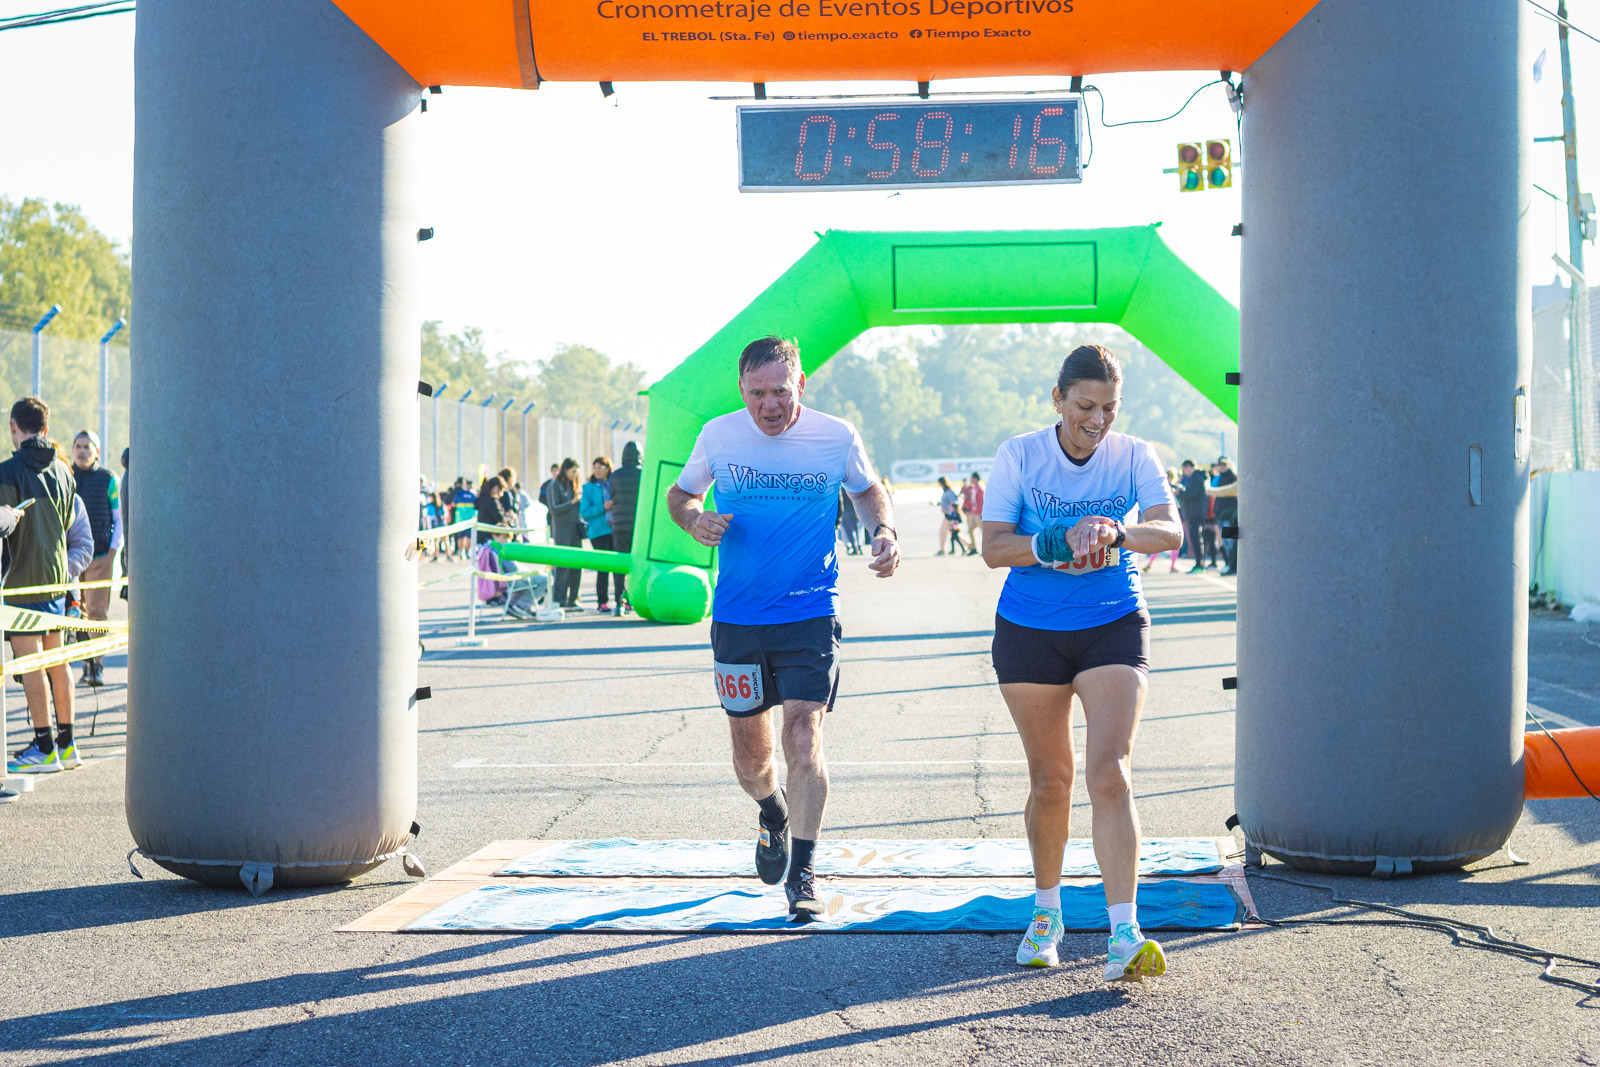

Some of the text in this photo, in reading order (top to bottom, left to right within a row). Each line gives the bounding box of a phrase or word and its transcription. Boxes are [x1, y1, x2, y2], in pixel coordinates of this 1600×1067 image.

[597, 0, 1074, 22] Cronometraje de Eventos Deportivos
[642, 28, 1032, 42] EL TREBOL (Sta. Fe) tiempo.exacto Tiempo Exacto
[752, 672, 760, 700] EXACTO
